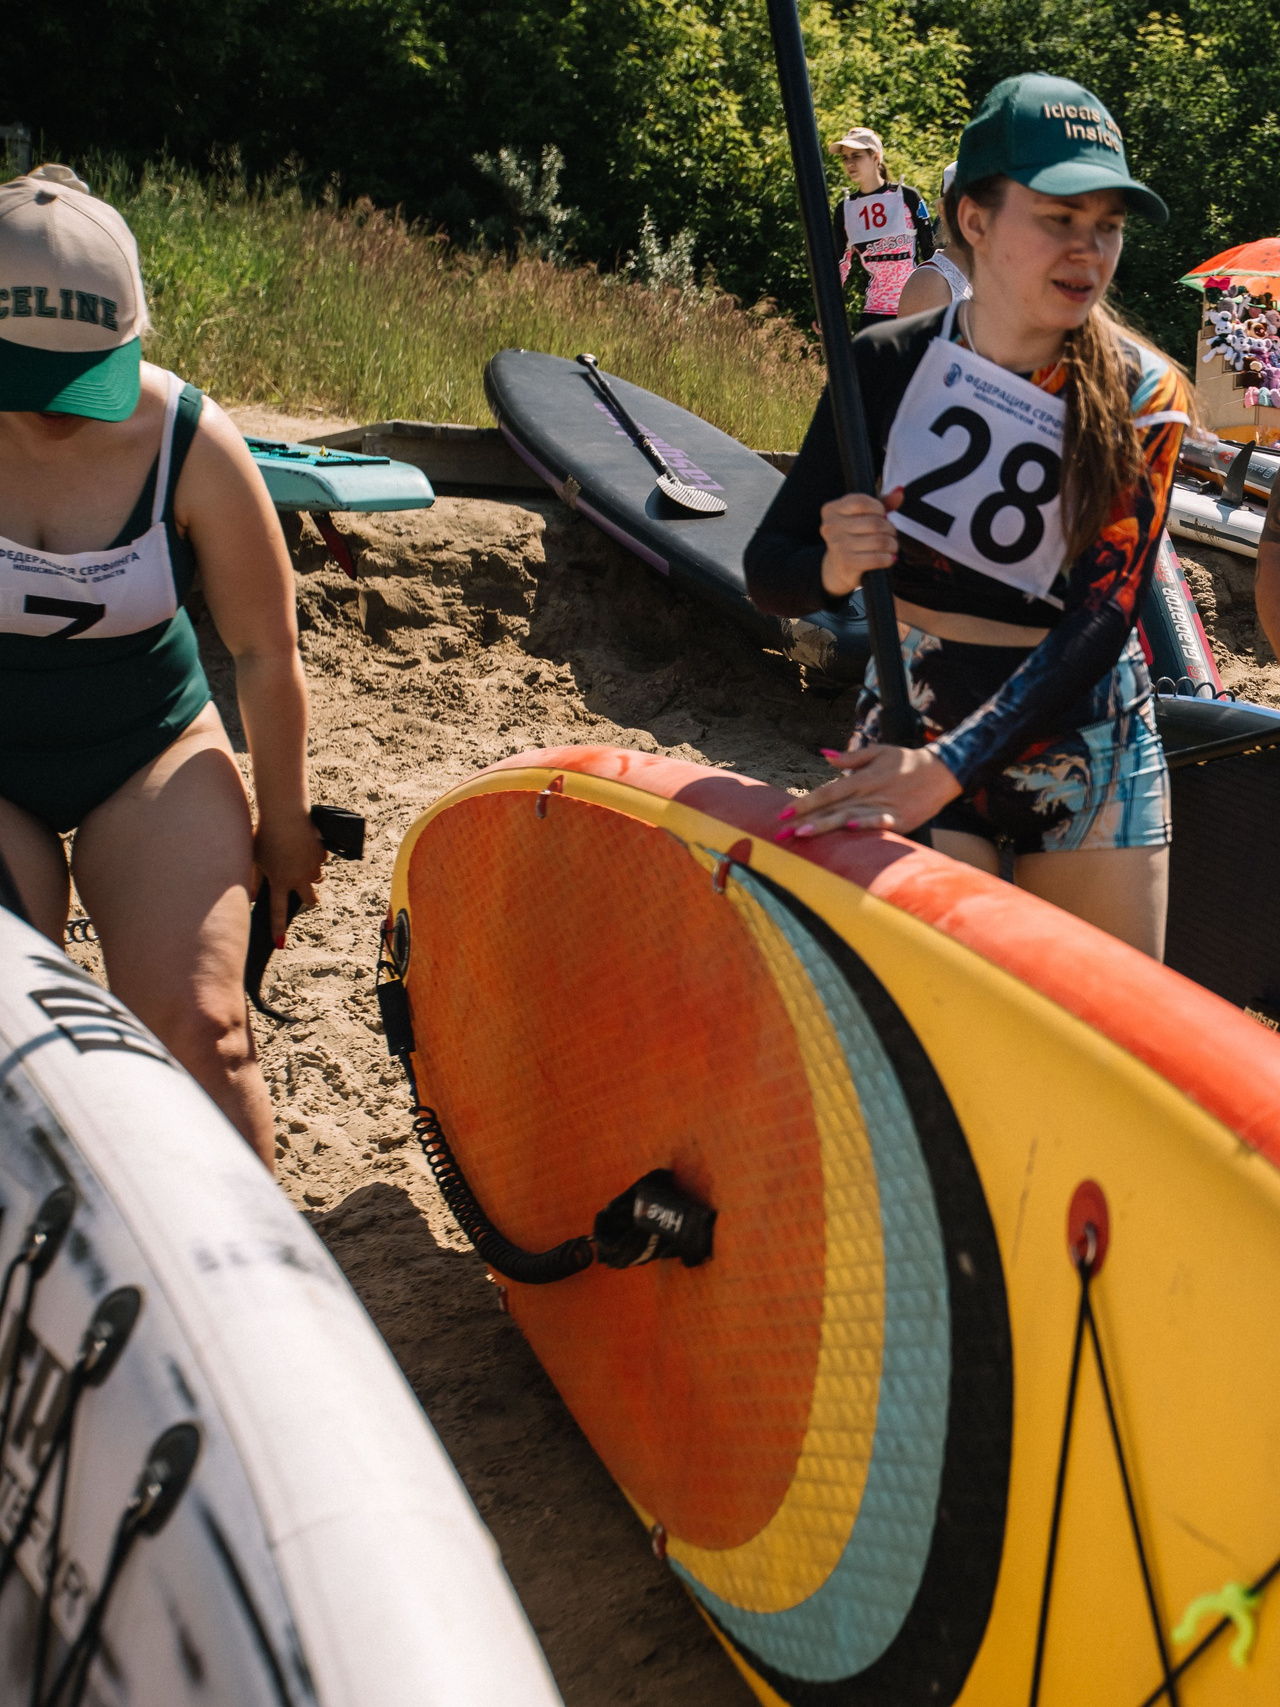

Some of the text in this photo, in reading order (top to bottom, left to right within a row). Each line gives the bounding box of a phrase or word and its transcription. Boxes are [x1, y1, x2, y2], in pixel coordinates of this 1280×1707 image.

[1043, 102, 1101, 123] Ideas
[858, 202, 888, 231] 18
[895, 404, 1063, 565] 28
[23, 593, 106, 640] 7
